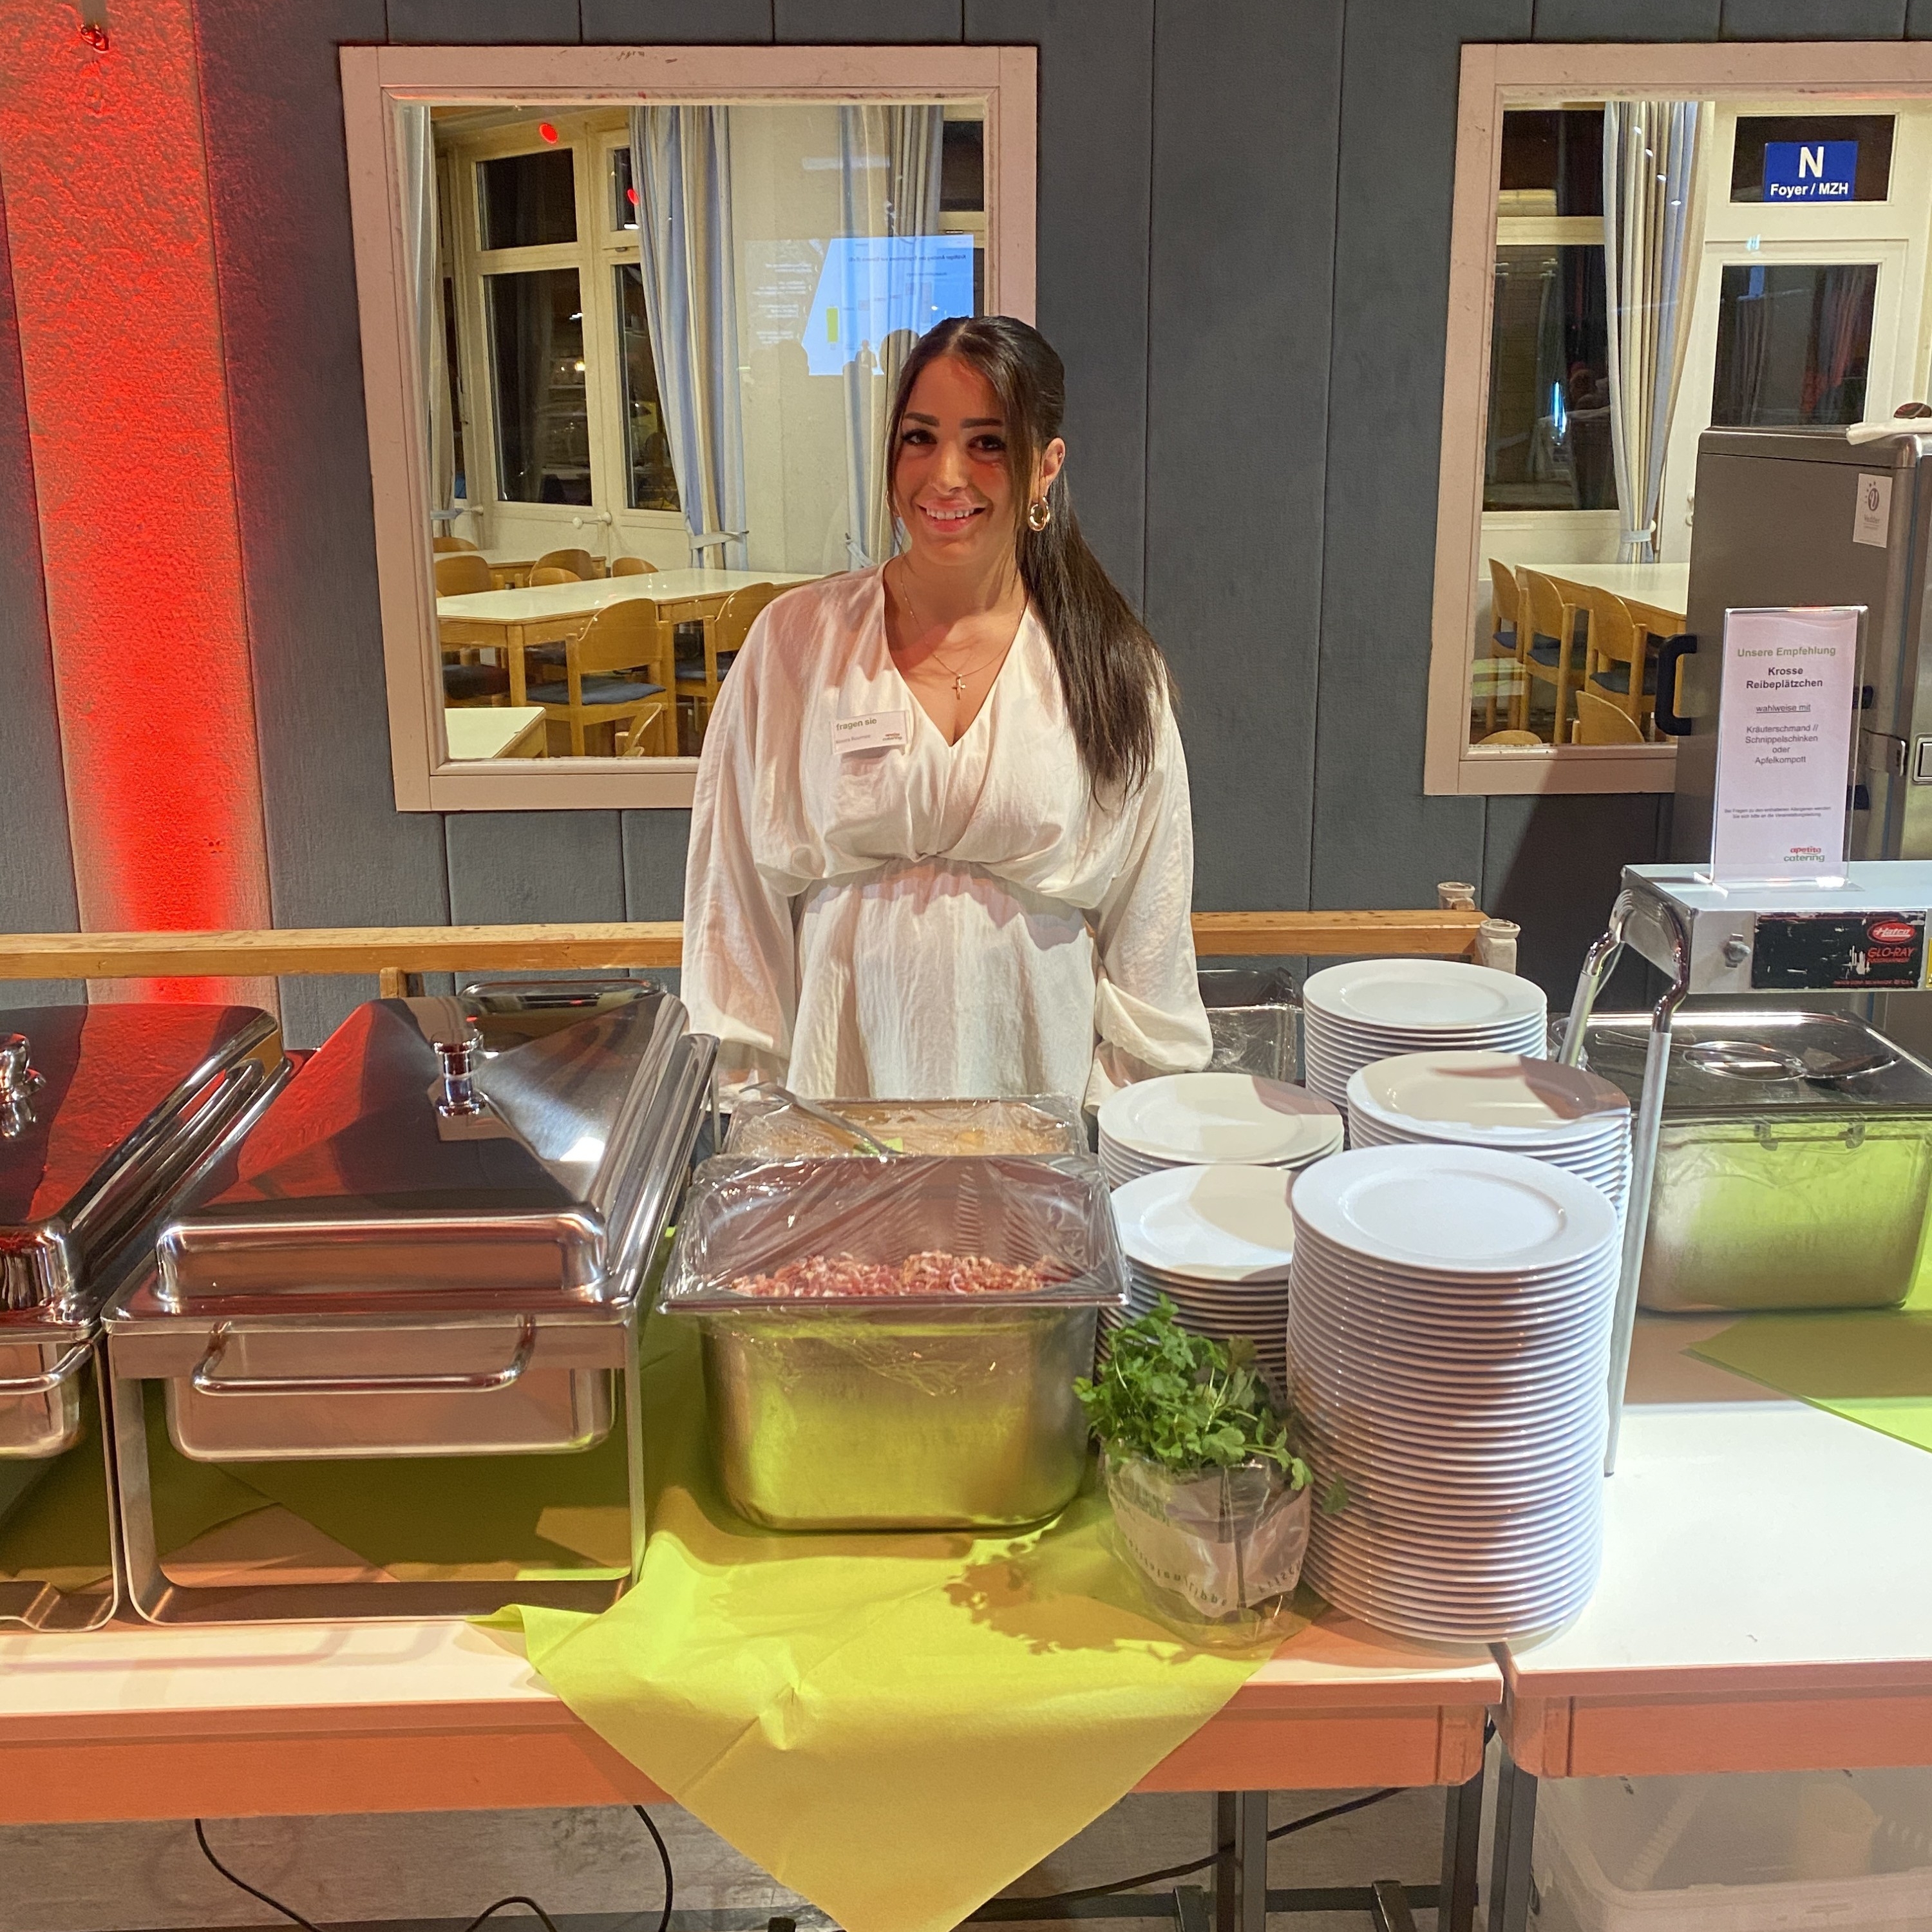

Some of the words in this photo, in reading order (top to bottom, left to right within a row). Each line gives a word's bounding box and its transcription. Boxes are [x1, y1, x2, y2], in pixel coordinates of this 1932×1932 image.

[1798, 146, 1824, 178] N
[1770, 184, 1809, 198] Foyer
[1810, 183, 1816, 195] /
[1819, 182, 1848, 195] MZH
[1738, 648, 1774, 657] Unsere
[1776, 647, 1836, 658] Empfehlung
[1768, 667, 1804, 676] Krosse
[1746, 679, 1823, 690] Reibeplätzchen
[1756, 704, 1797, 713] wahlweise
[1799, 704, 1811, 712] mit
[836, 720, 863, 731] fragen
[1746, 724, 1811, 733] Kräuterschmand
[1745, 735, 1819, 744] Schnippelschinken
[1755, 756, 1806, 765] Apfelkompott
[1790, 846, 1822, 855] apetito
[1784, 854, 1825, 862] catering
[1873, 927, 1912, 938] Hatco
[1868, 947, 1915, 958] GLO-RAY
